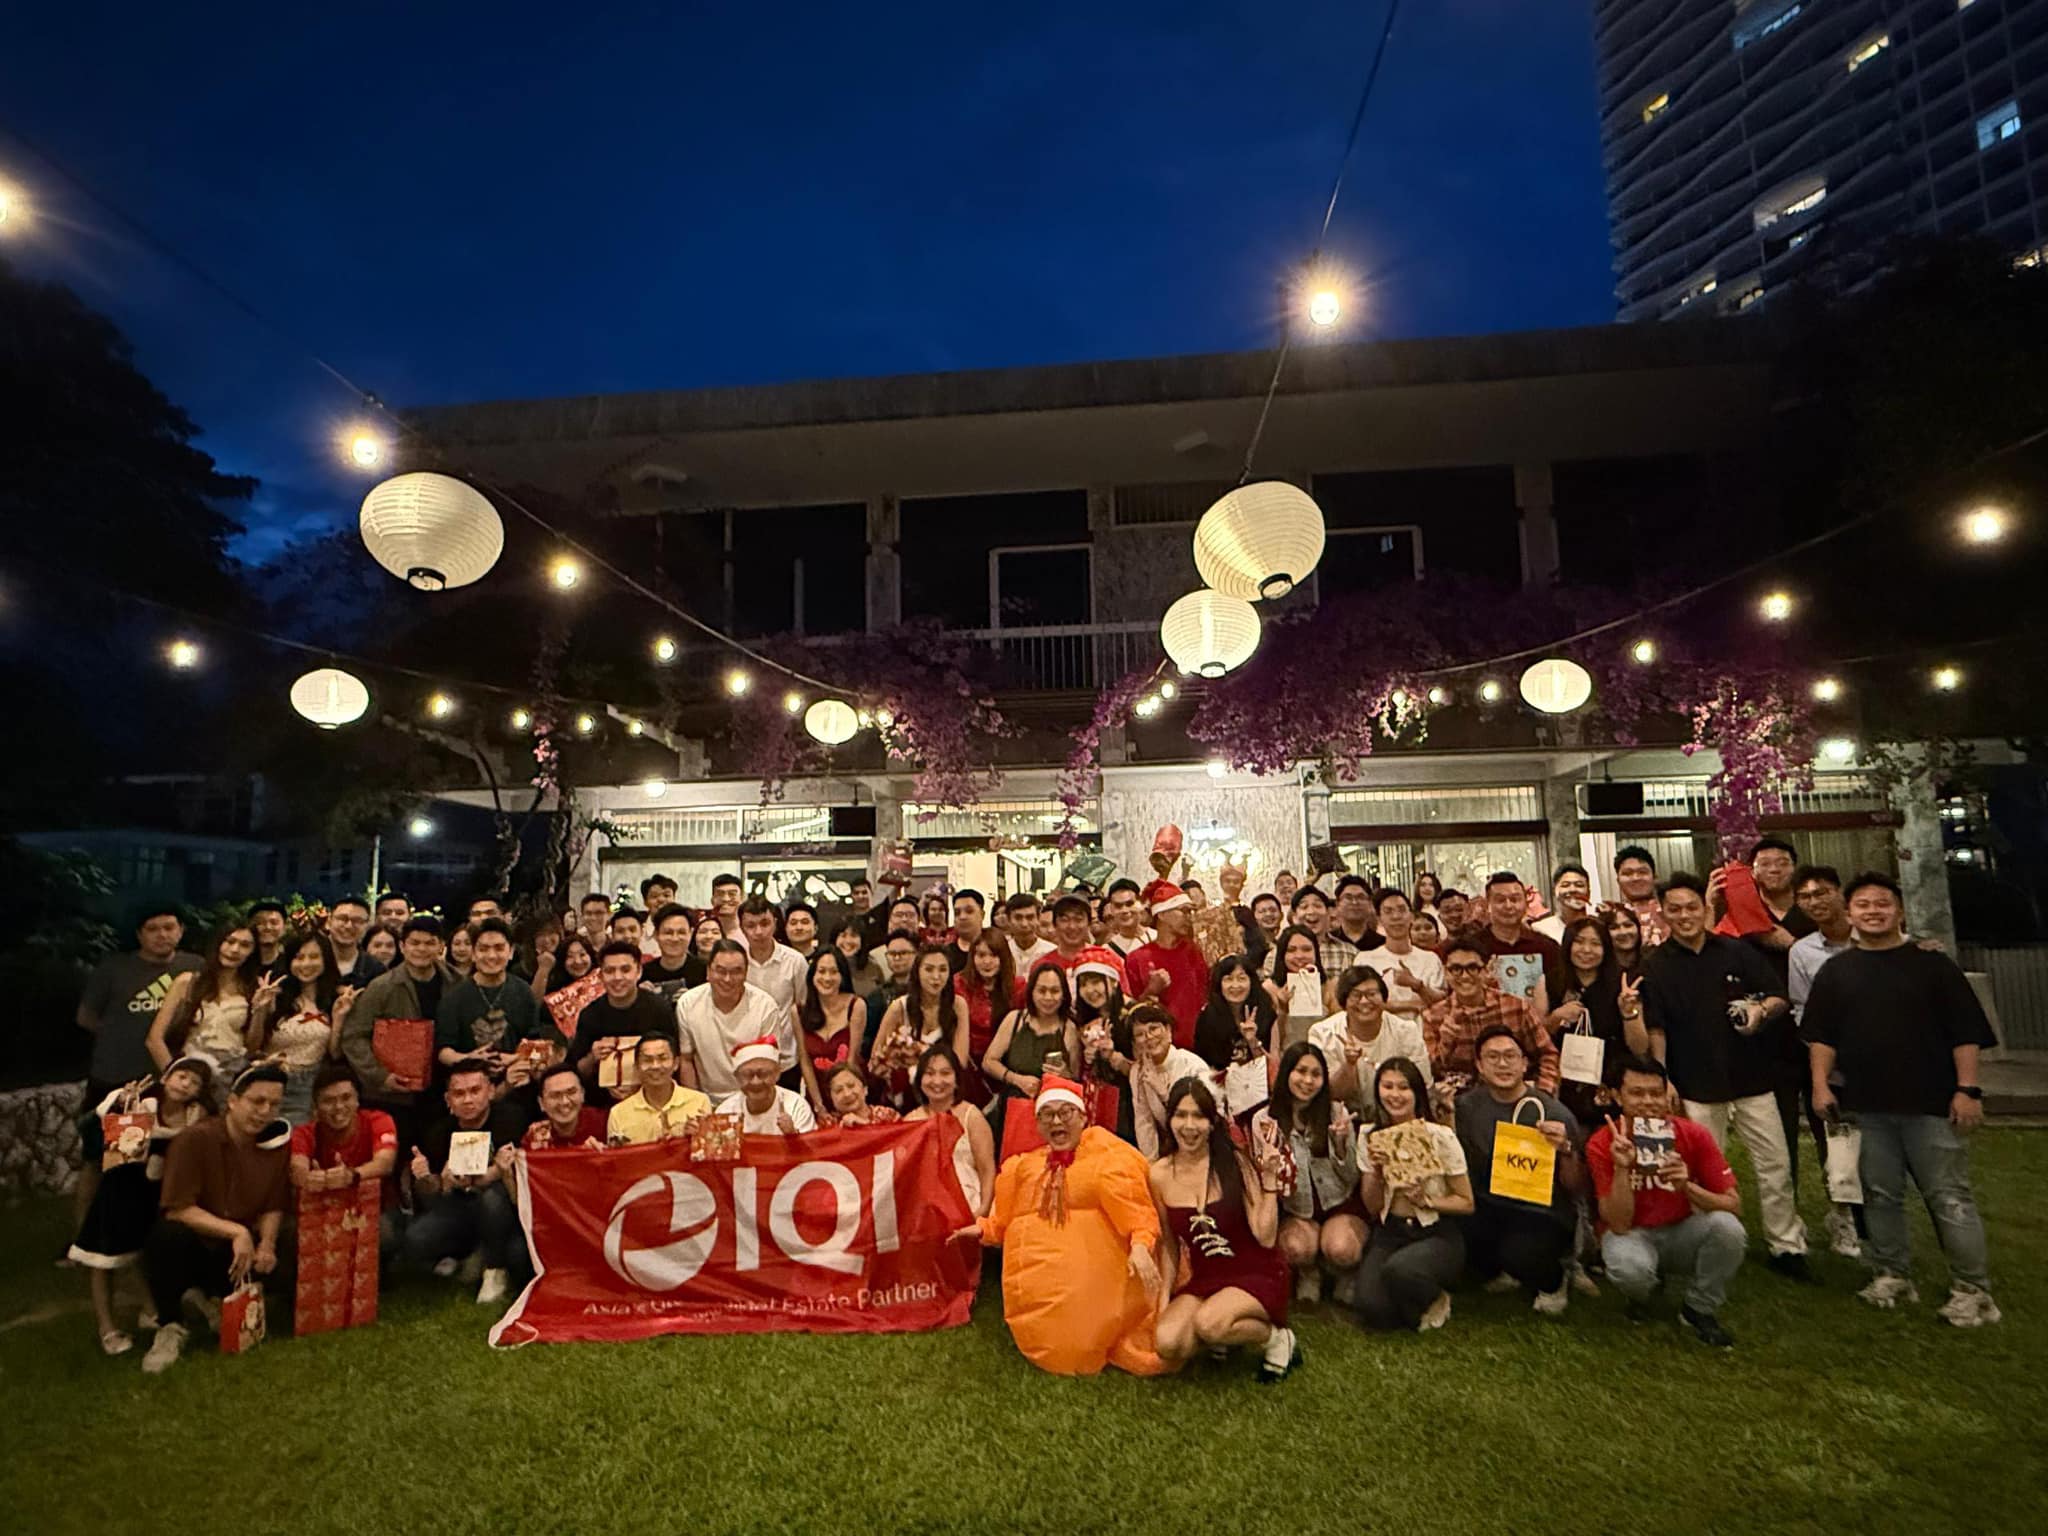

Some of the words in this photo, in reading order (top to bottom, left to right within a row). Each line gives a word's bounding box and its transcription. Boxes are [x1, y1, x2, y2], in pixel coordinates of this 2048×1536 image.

[1507, 1153, 1538, 1171] KKV
[733, 1149, 899, 1274] IQI
[857, 1281, 938, 1311] Partner
